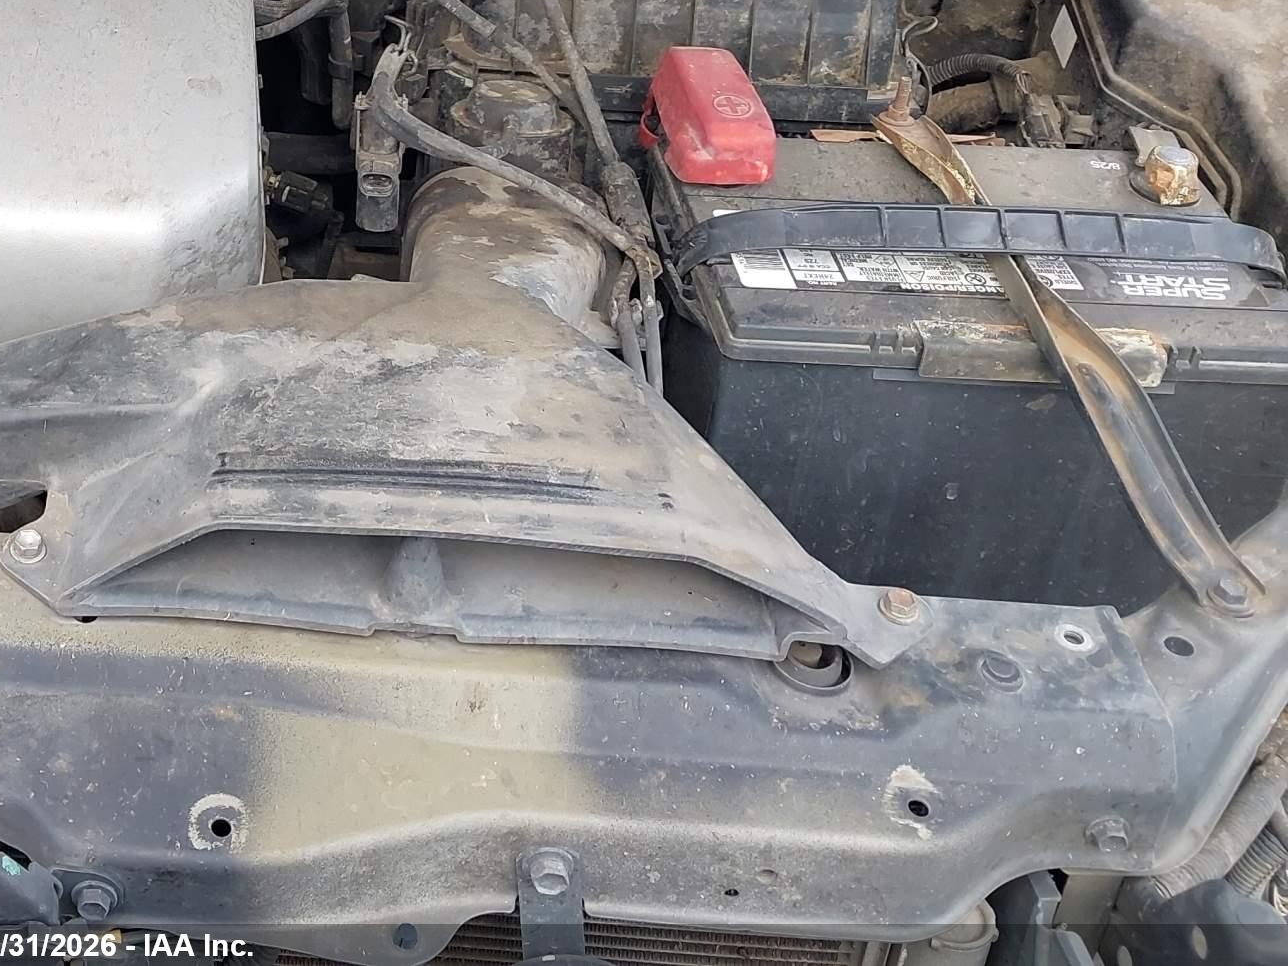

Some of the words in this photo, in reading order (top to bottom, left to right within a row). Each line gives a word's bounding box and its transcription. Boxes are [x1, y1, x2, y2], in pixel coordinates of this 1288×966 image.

[1090, 160, 1121, 170] 8/25
[899, 283, 1005, 294] ANGER/POISON
[1118, 274, 1231, 291] START
[1123, 285, 1227, 300] SUPER
